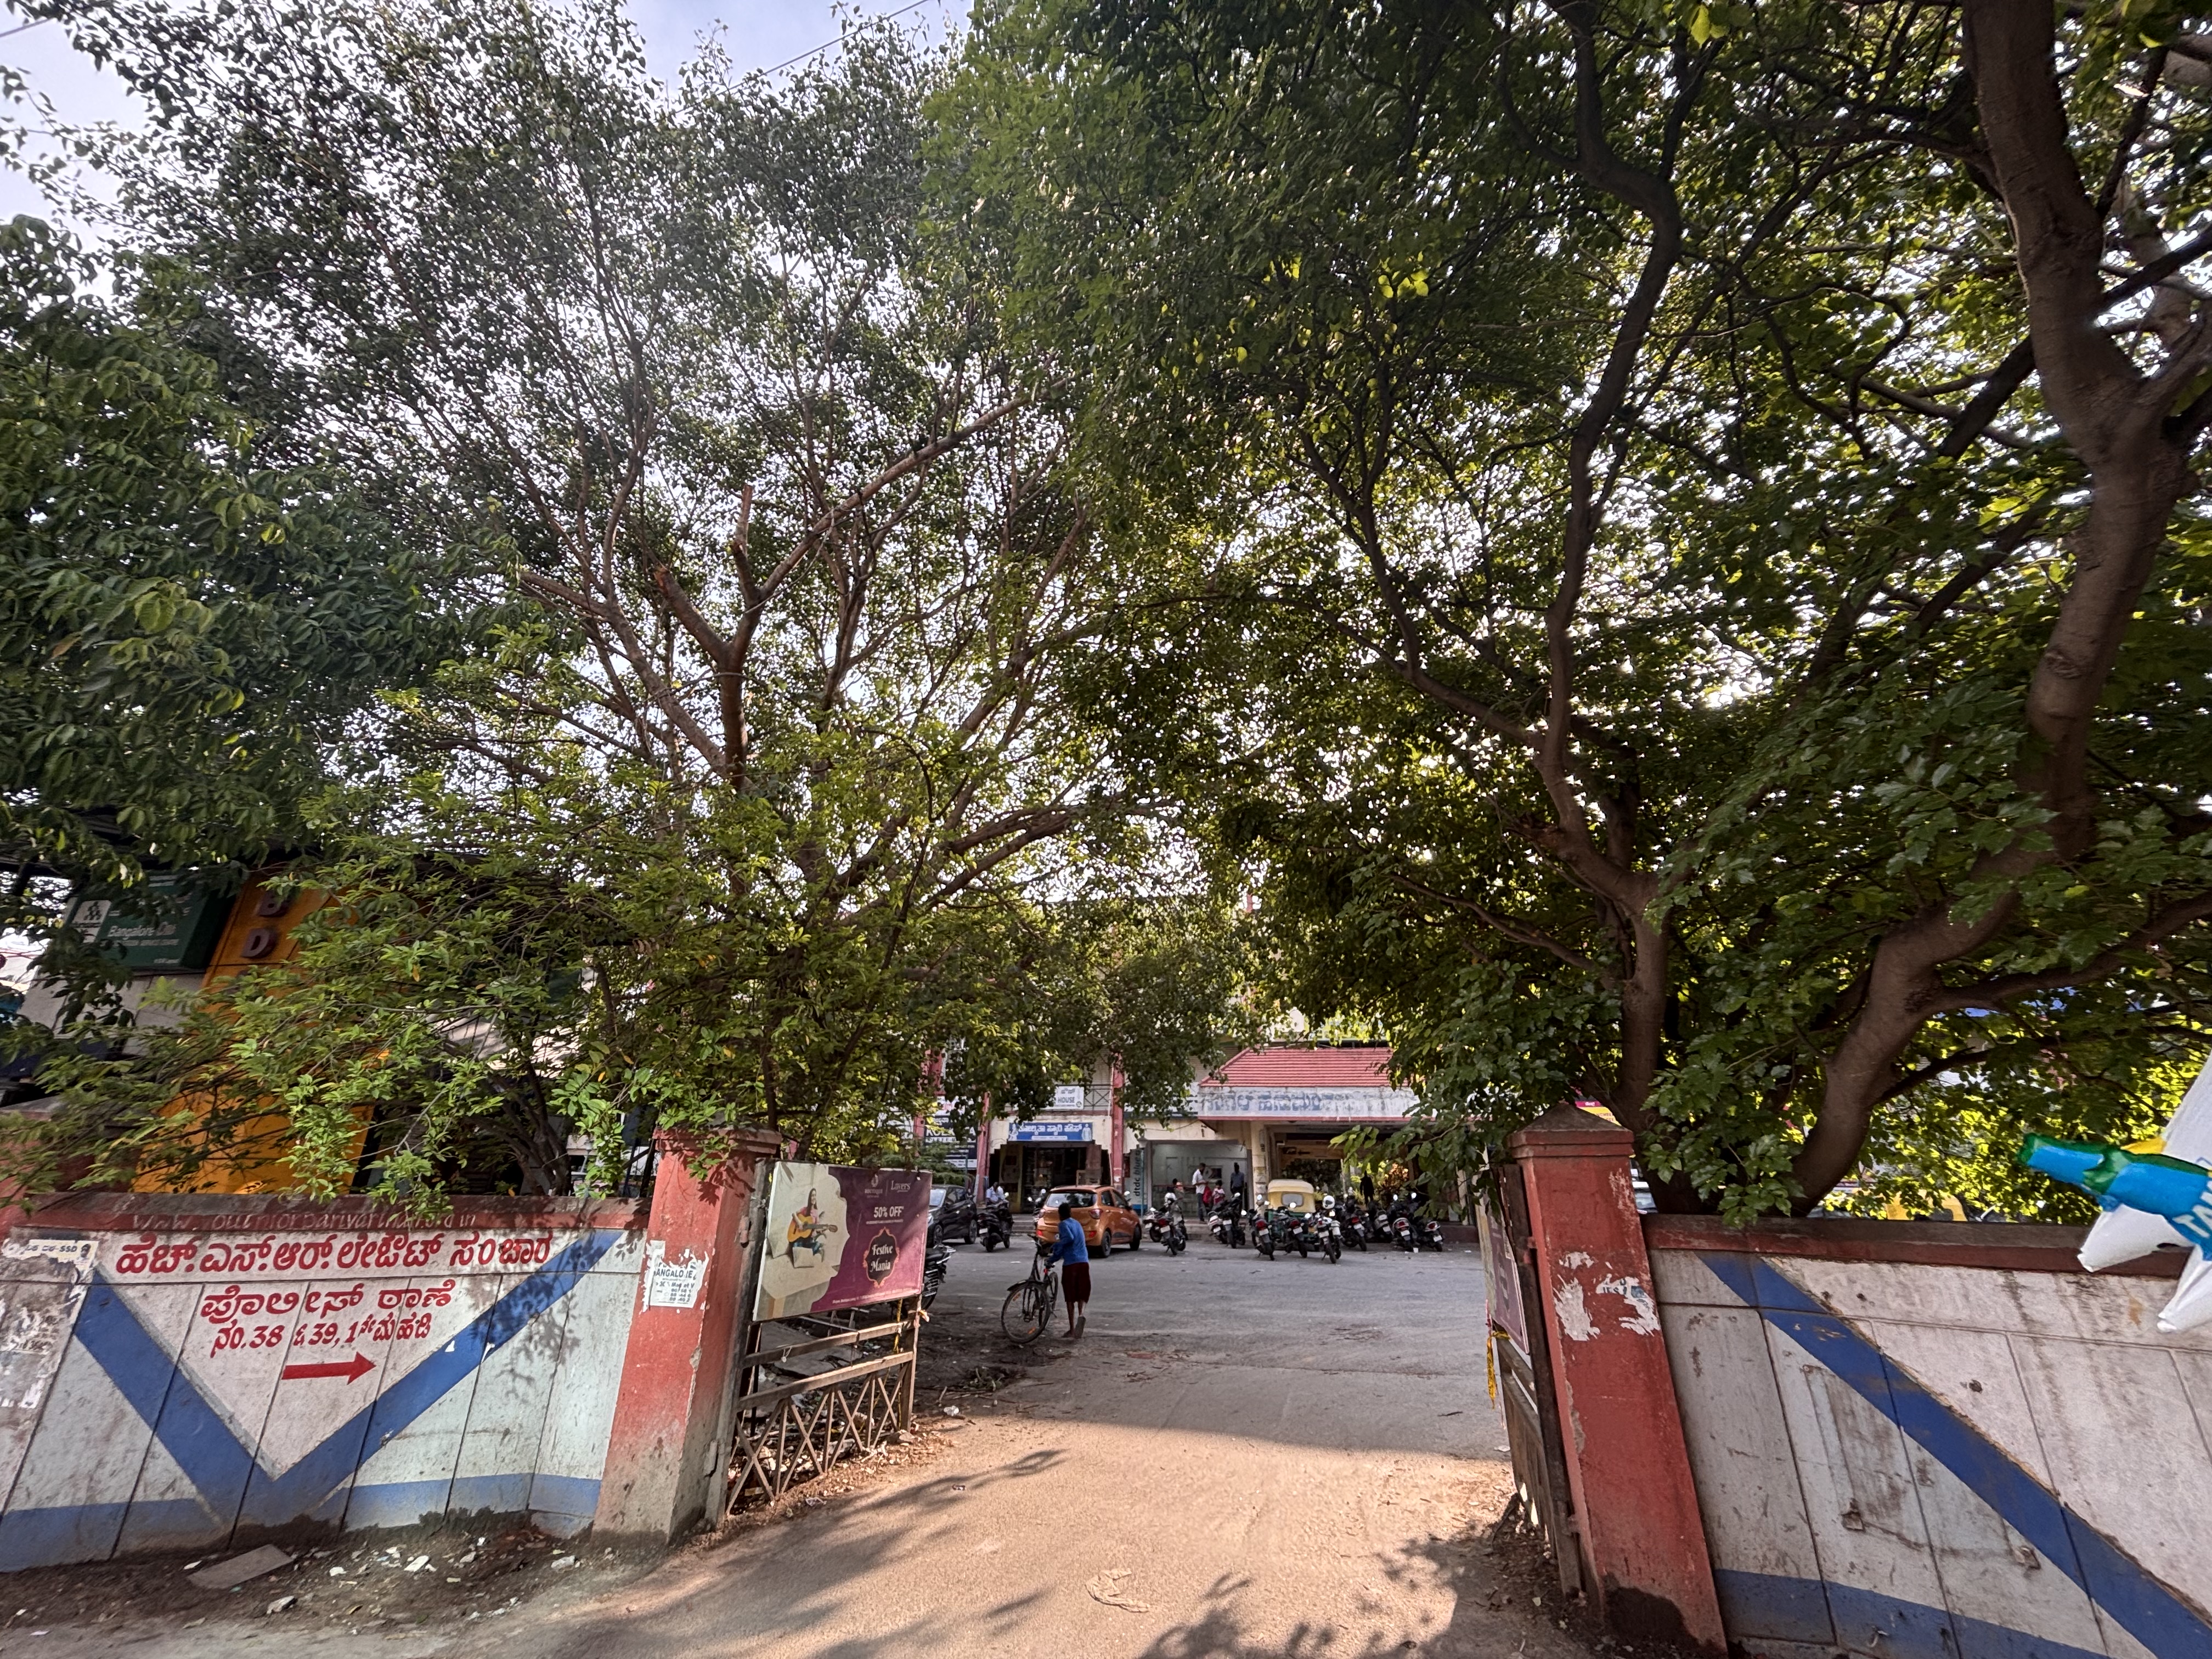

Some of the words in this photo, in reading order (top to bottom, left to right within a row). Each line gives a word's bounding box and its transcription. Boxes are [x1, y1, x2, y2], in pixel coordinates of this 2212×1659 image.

[108, 925, 155, 940] Bangalore
[873, 1206, 888, 1218] 50%
[450, 1229, 554, 1266] ಸಂಚಾರ
[871, 1244, 894, 1256] Festive
[870, 1258, 891, 1273] Mania
[377, 1279, 456, 1310] ಠಾಣೆ
